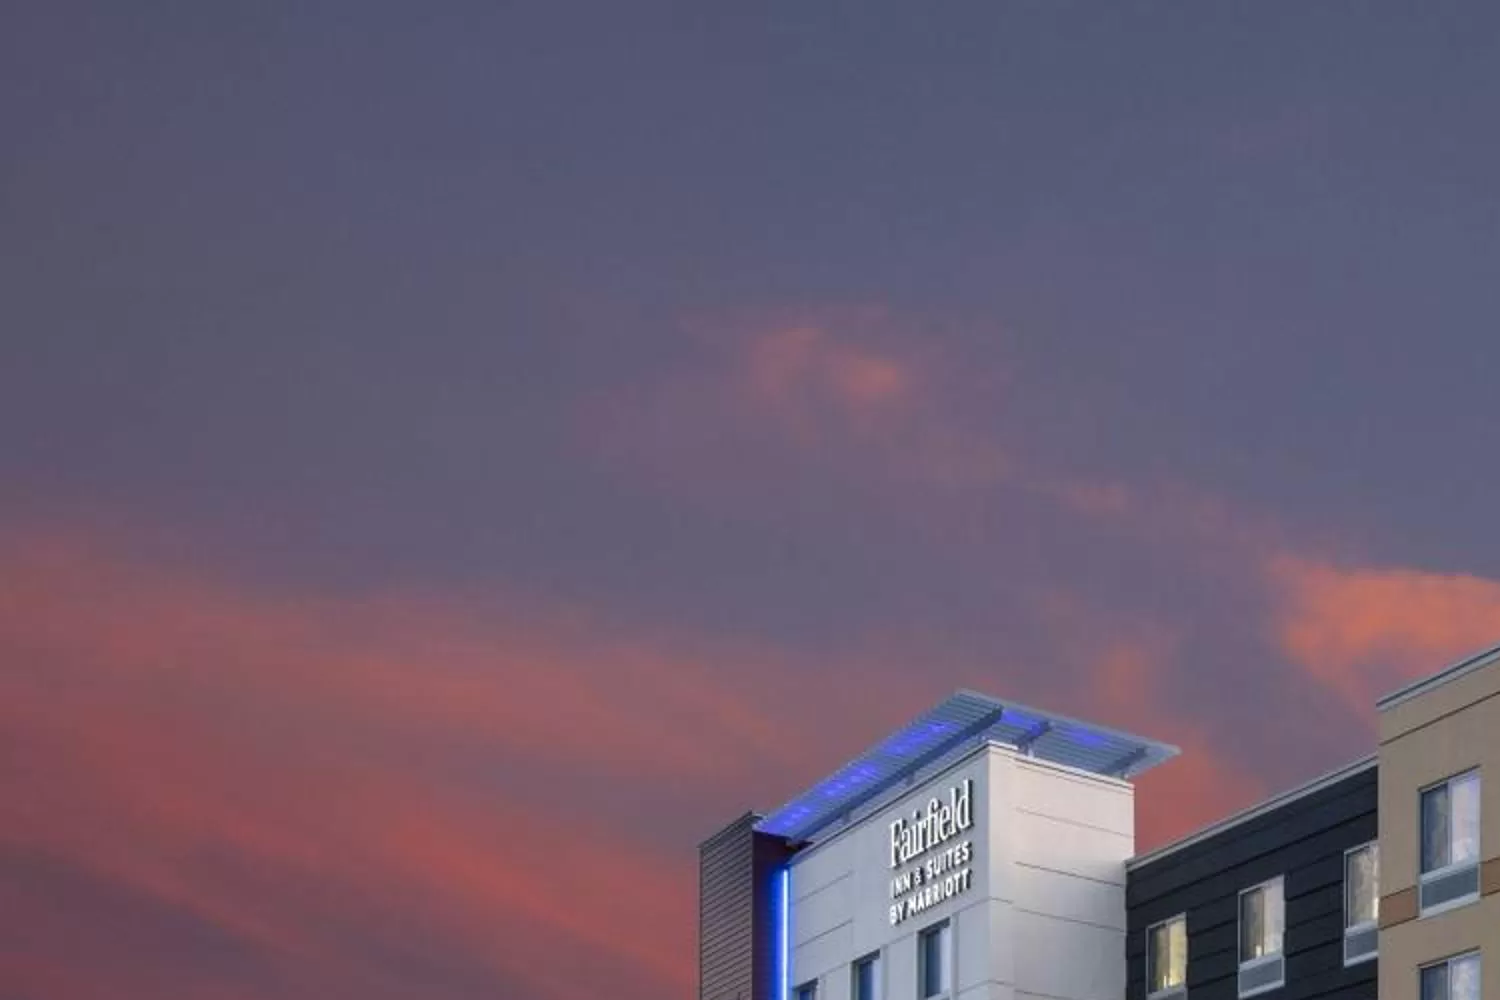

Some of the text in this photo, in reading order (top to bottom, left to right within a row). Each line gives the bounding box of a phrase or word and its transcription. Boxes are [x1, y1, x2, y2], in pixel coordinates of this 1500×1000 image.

[889, 778, 973, 868] Fairfield
[889, 868, 971, 925] BY MARRIOTT
[890, 841, 971, 899] INN & SUITES
